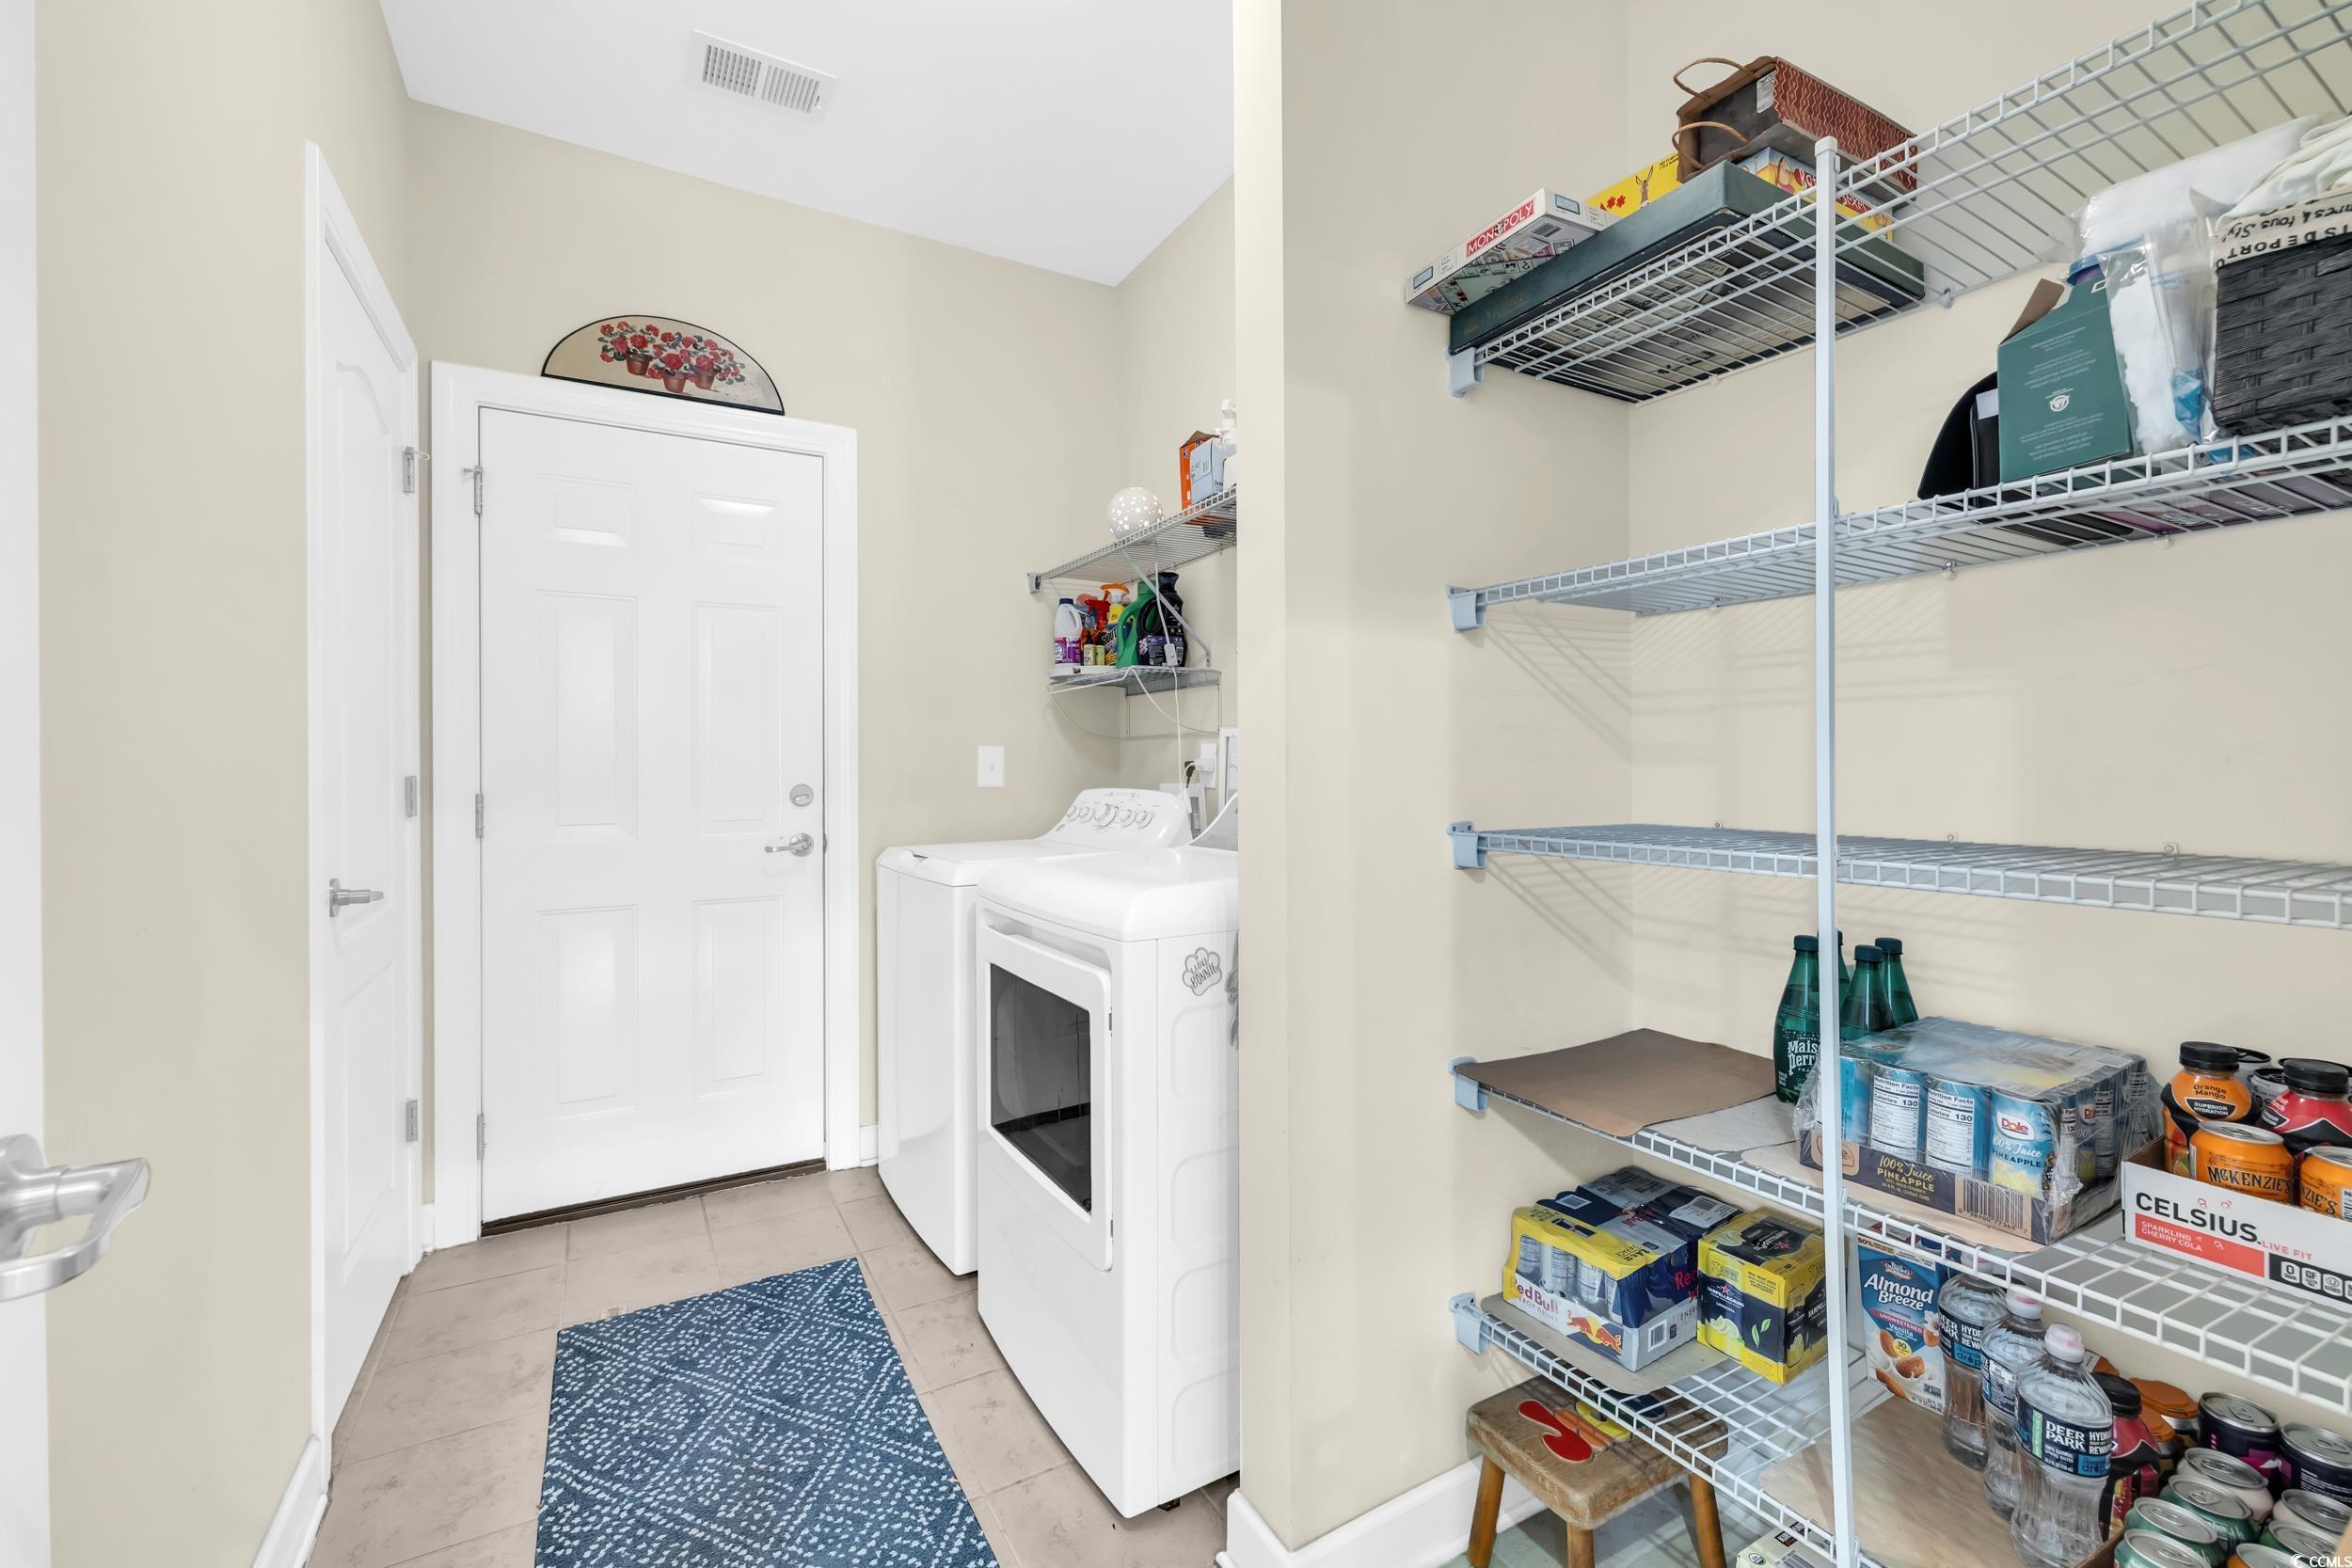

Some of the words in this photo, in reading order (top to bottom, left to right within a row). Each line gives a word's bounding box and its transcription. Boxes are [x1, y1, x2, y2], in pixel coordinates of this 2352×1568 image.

[1468, 200, 1534, 256] MONOPOLY
[2228, 238, 2280, 259] PORT
[1190, 963, 1218, 989] BONNIE
[1788, 1040, 1819, 1053] Mais
[1788, 1053, 1816, 1076] Perr
[1875, 1078, 1899, 1087] Nutrition
[2193, 1084, 2228, 1095] Orange
[1874, 1094, 1898, 1104] Calories
[1929, 1091, 1952, 1101] Nutrition
[2195, 1090, 2226, 1100] Mango
[2194, 1101, 2228, 1111] SUPERIOR
[2194, 1106, 2229, 1116] HYDRATION
[1955, 1114, 1973, 1122] 130
[2001, 1117, 2029, 1133] Dole
[1992, 1148, 2042, 1168] PINEAPPLE
[2013, 1143, 2042, 1158] Juice
[1879, 1155, 1903, 1173] 100%
[1904, 1164, 1934, 1182] Juice
[1877, 1167, 1935, 1193] PINEAPPLE
[2141, 1221, 2192, 1242] SPARKLING
[2141, 1227, 2177, 1244] CHERRY
[2178, 1238, 2202, 1253] COLA
[2263, 1242, 2289, 1255] LIVE
[2293, 1248, 2313, 1260] FIT
[1864, 1273, 1933, 1305] Almond
[1534, 1291, 1558, 1313] Bull
[1808, 1301, 1827, 1317] SANPELL
[1878, 1290, 1924, 1311] Breeze
[1880, 1312, 1923, 1333] UNSWEETENED
[1888, 1323, 1914, 1338] Vanilla
[1897, 1340, 1907, 1350] 30
[2045, 1419, 2085, 1442] DEER
[2045, 1429, 2087, 1453] PARK
